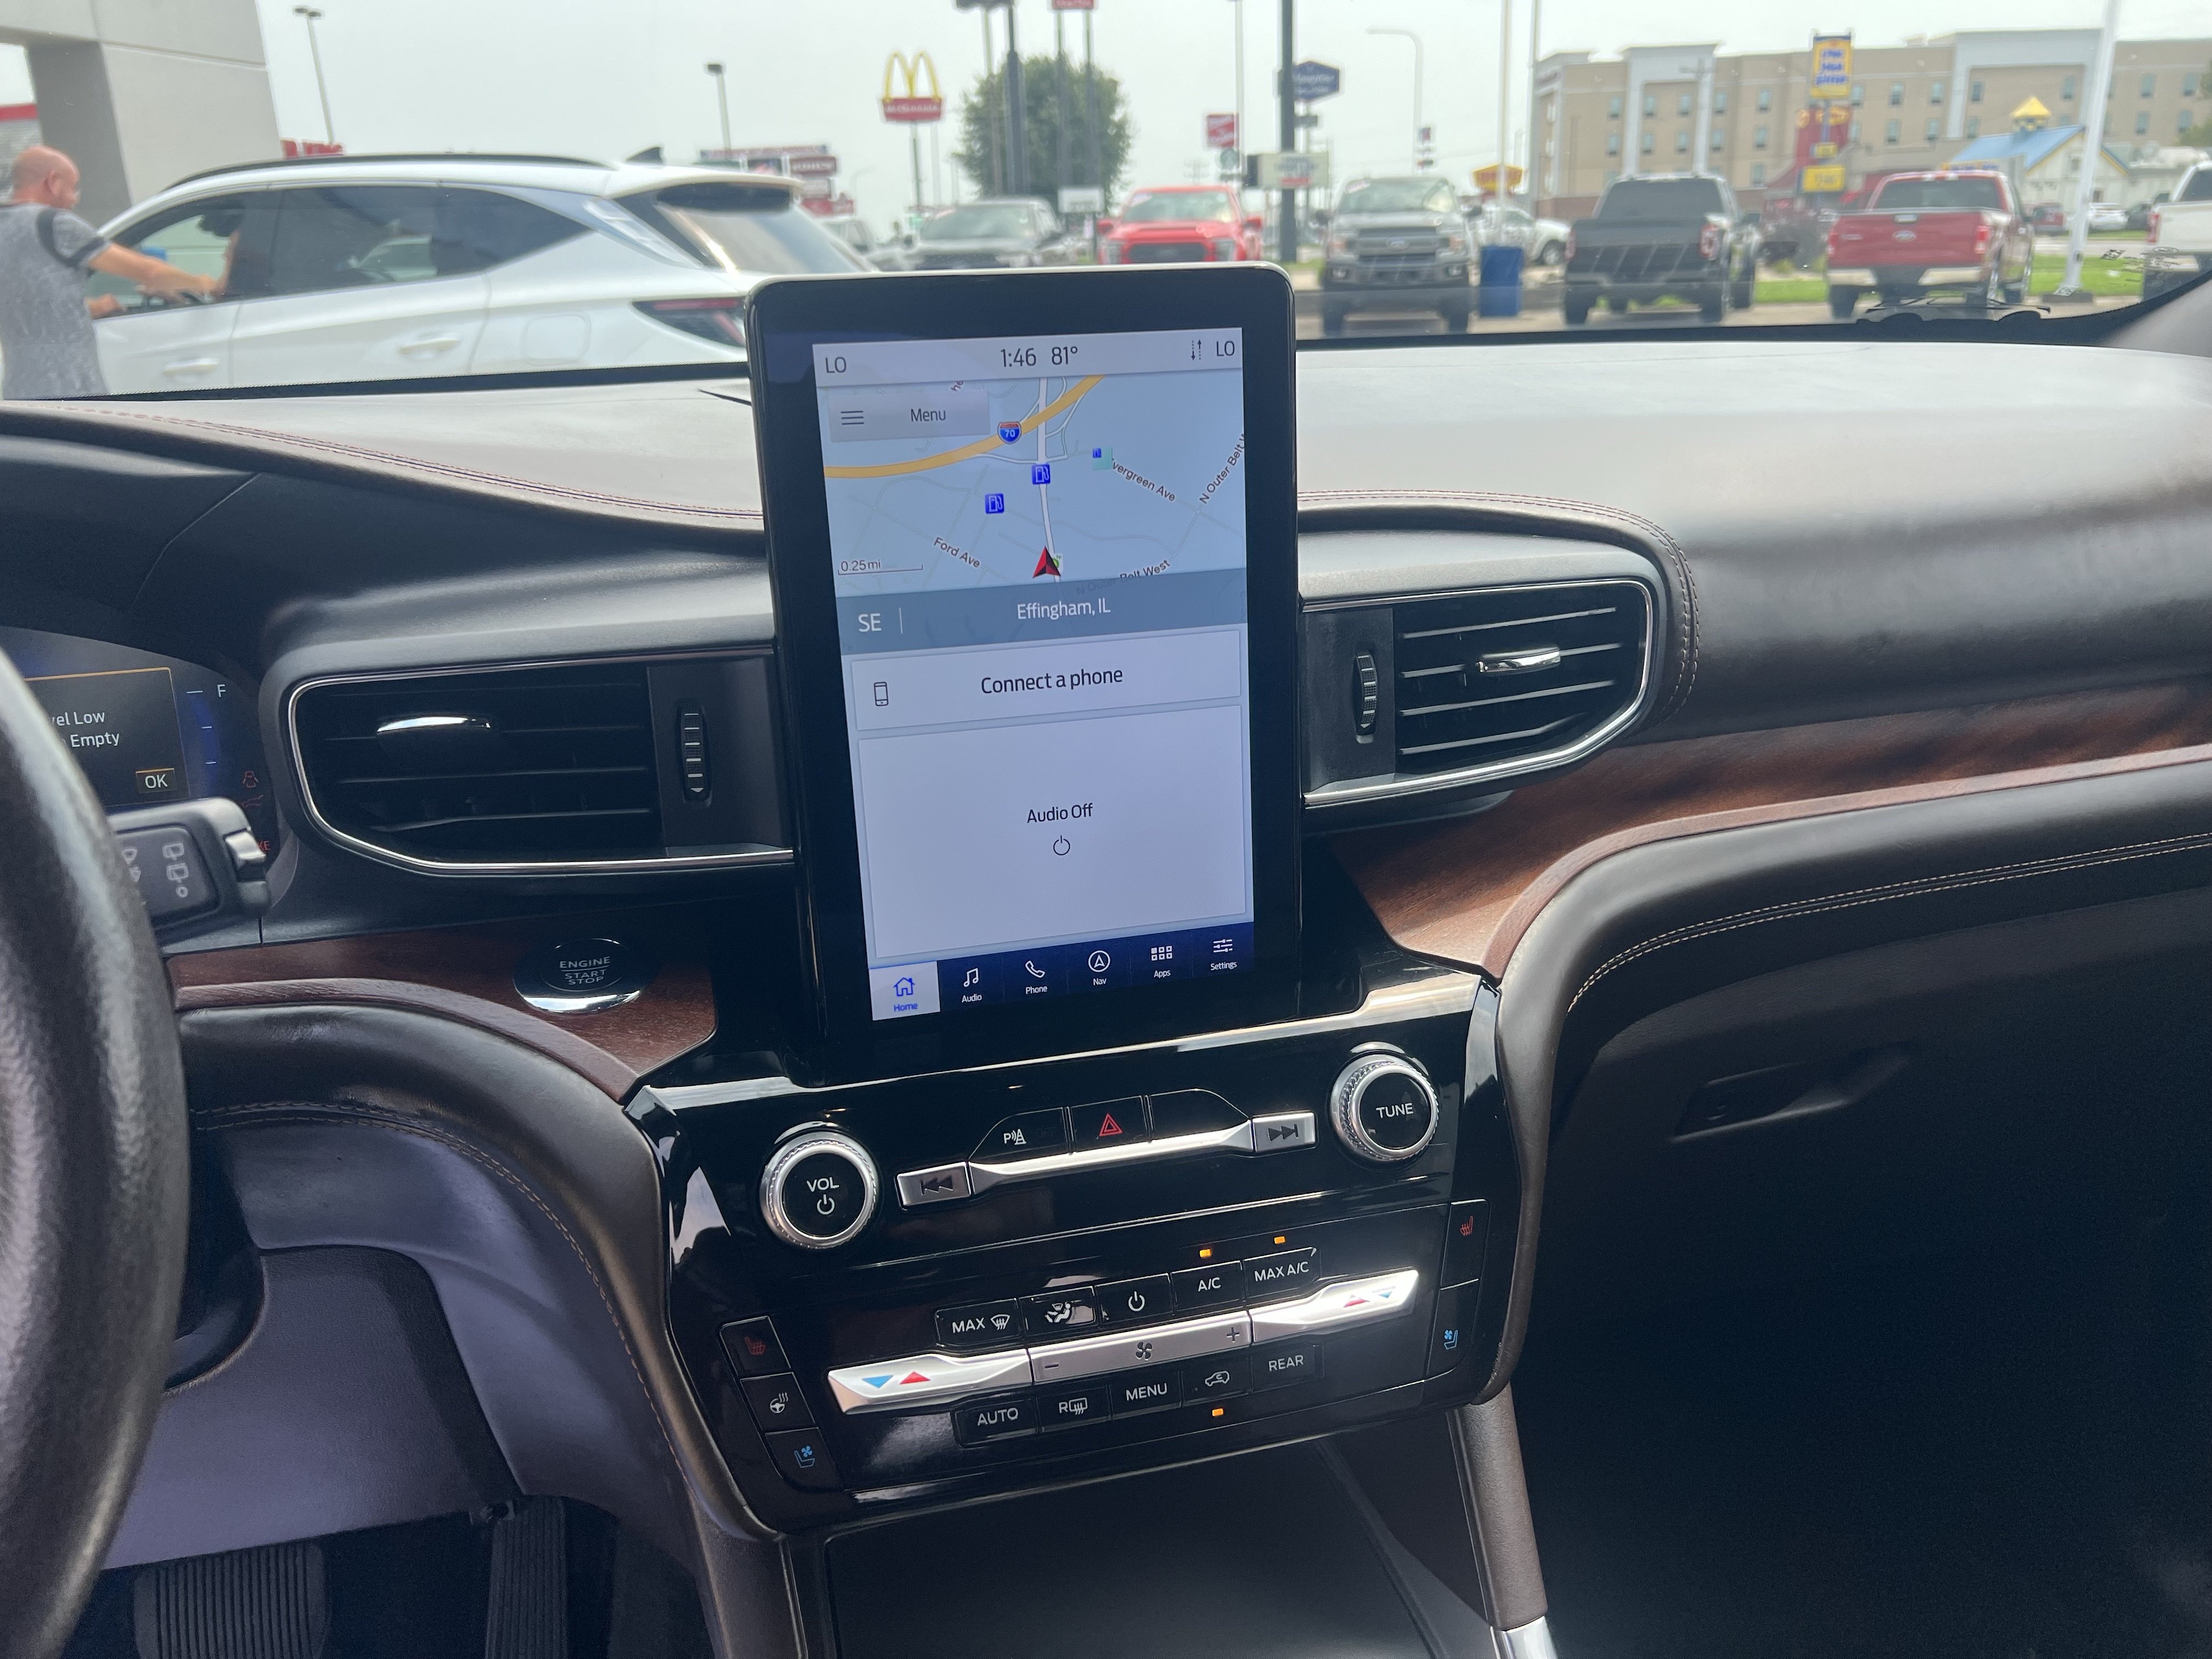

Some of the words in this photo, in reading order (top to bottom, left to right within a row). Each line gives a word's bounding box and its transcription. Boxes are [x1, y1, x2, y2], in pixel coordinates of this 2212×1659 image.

[1000, 348, 1037, 368] 1:46
[1051, 346, 1078, 366] 81°
[1216, 340, 1235, 357] LO
[825, 356, 847, 374] LO
[910, 408, 946, 422] Menu
[1005, 430, 1015, 438] 70
[1112, 458, 1155, 491] vergreen
[1155, 486, 1175, 501] Ave
[1199, 493, 1210, 504] N
[1206, 466, 1230, 493] Outer
[1227, 444, 1245, 466] Belt
[934, 537, 959, 557] Ford
[960, 552, 980, 568] Ave
[1142, 560, 1171, 577] West
[1017, 600, 1096, 620] Effingham,
[1098, 597, 1111, 614] IL
[858, 613, 882, 633] SE
[981, 673, 1053, 694] Connect
[1056, 674, 1066, 687] a
[1070, 668, 1123, 690] phone
[217, 684, 227, 698] F
[73, 711, 105, 725] Low
[70, 731, 120, 748] Empty
[144, 773, 168, 789] OK
[1026, 806, 1069, 823] Audio
[1071, 802, 1093, 819] Off
[560, 956, 611, 968] ENGINE
[1210, 960, 1238, 971] Settings
[565, 969, 607, 980] START
[568, 976, 604, 985] STOP
[1092, 977, 1107, 986] Nav
[1153, 969, 1171, 979] Apps
[961, 993, 983, 1003] Audio
[1025, 985, 1048, 995] Phone
[893, 1002, 918, 1012] Home
[1375, 1102, 1414, 1119] TUNE
[806, 1176, 840, 1192] VOL
[1254, 1265, 1285, 1282] MAX
[1286, 1261, 1310, 1276] A/C
[1198, 1277, 1222, 1292] A/C
[952, 1317, 986, 1334] MAX
[1268, 1355, 1304, 1372] REAR
[1125, 1382, 1168, 1401] MENU
[977, 1407, 1019, 1426] AUTO
